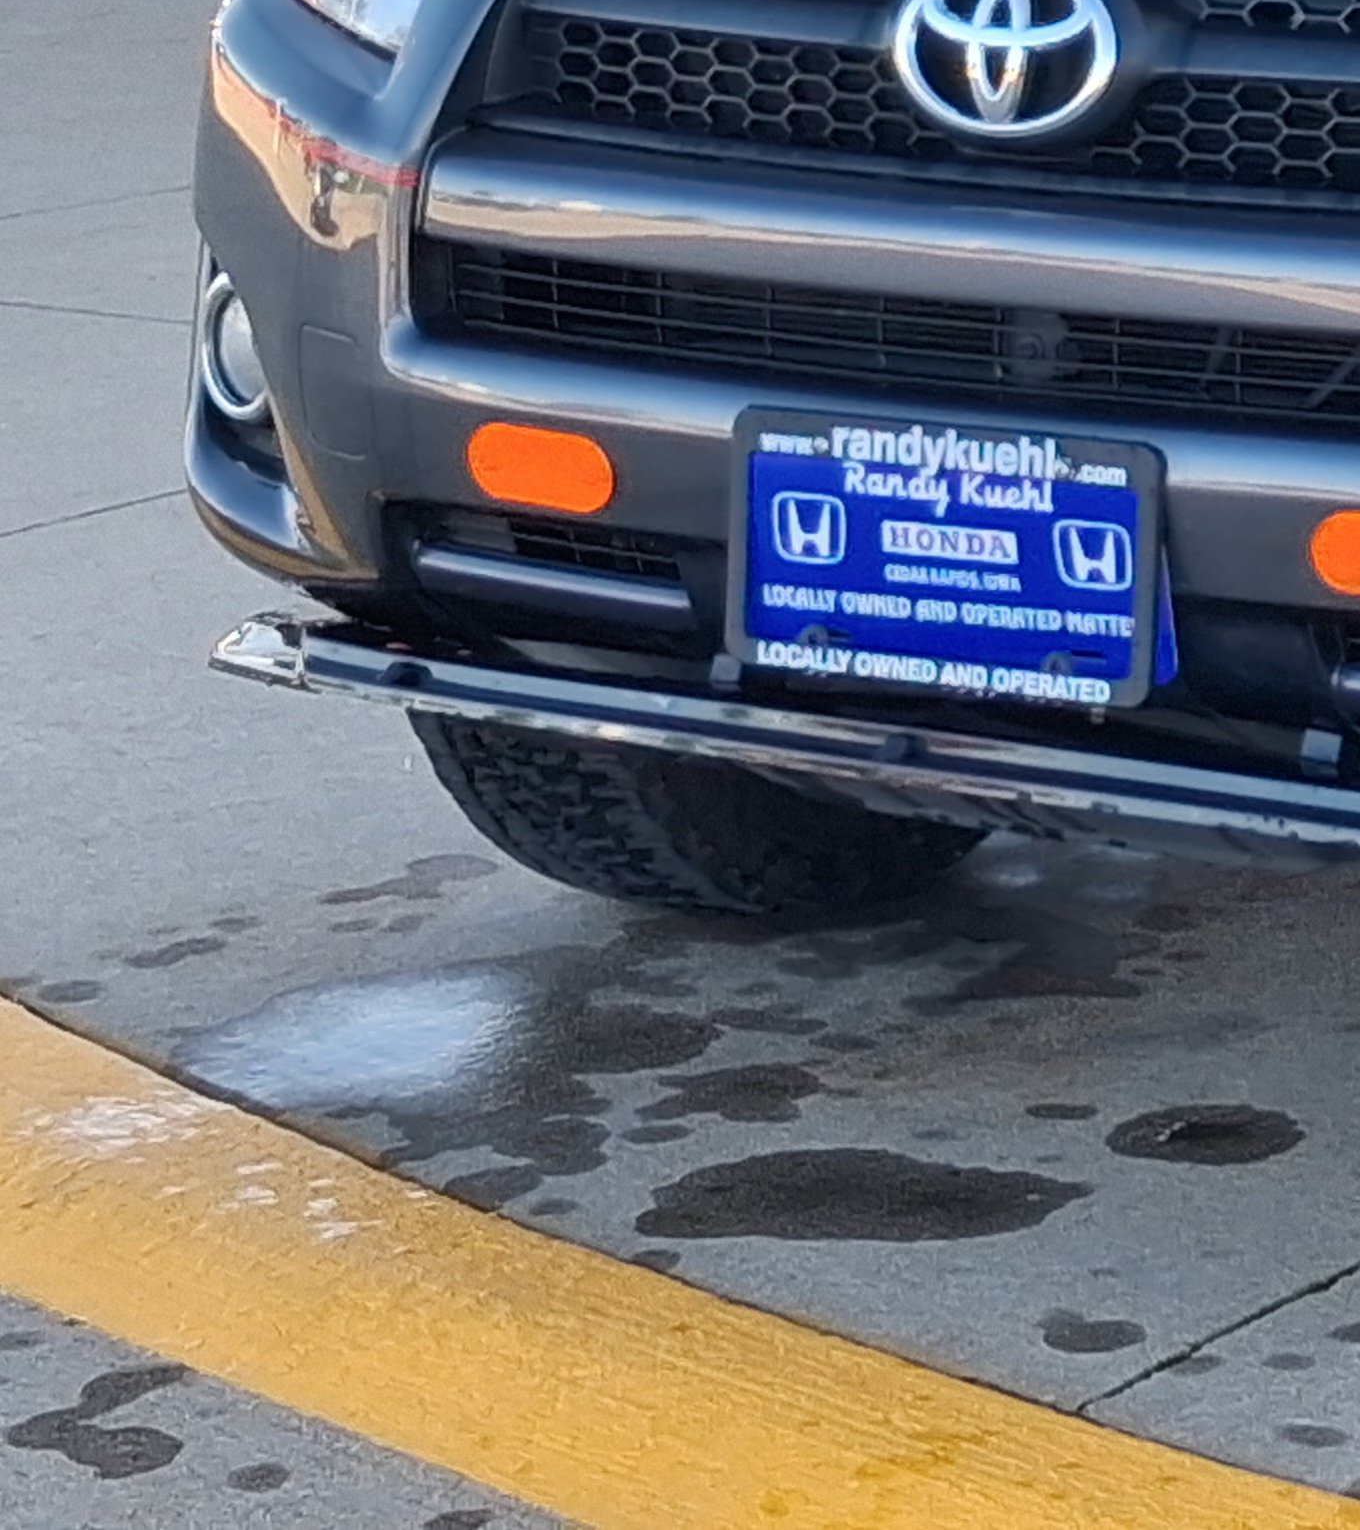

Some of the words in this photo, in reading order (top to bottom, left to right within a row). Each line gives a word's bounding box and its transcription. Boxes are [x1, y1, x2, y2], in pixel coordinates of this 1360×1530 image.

[842, 460, 950, 518] Randy
[960, 473, 1054, 513] Kuehl
[890, 525, 1011, 559] HONDA
[762, 583, 836, 613] LOCALLY
[839, 591, 912, 619] OWNED
[915, 599, 957, 623] AND
[960, 602, 1062, 631] OPERATED
[756, 639, 853, 674] LOCALLY
[854, 651, 938, 684] OWNED
[940, 661, 988, 689] AND
[991, 666, 1111, 704] OPERATED
